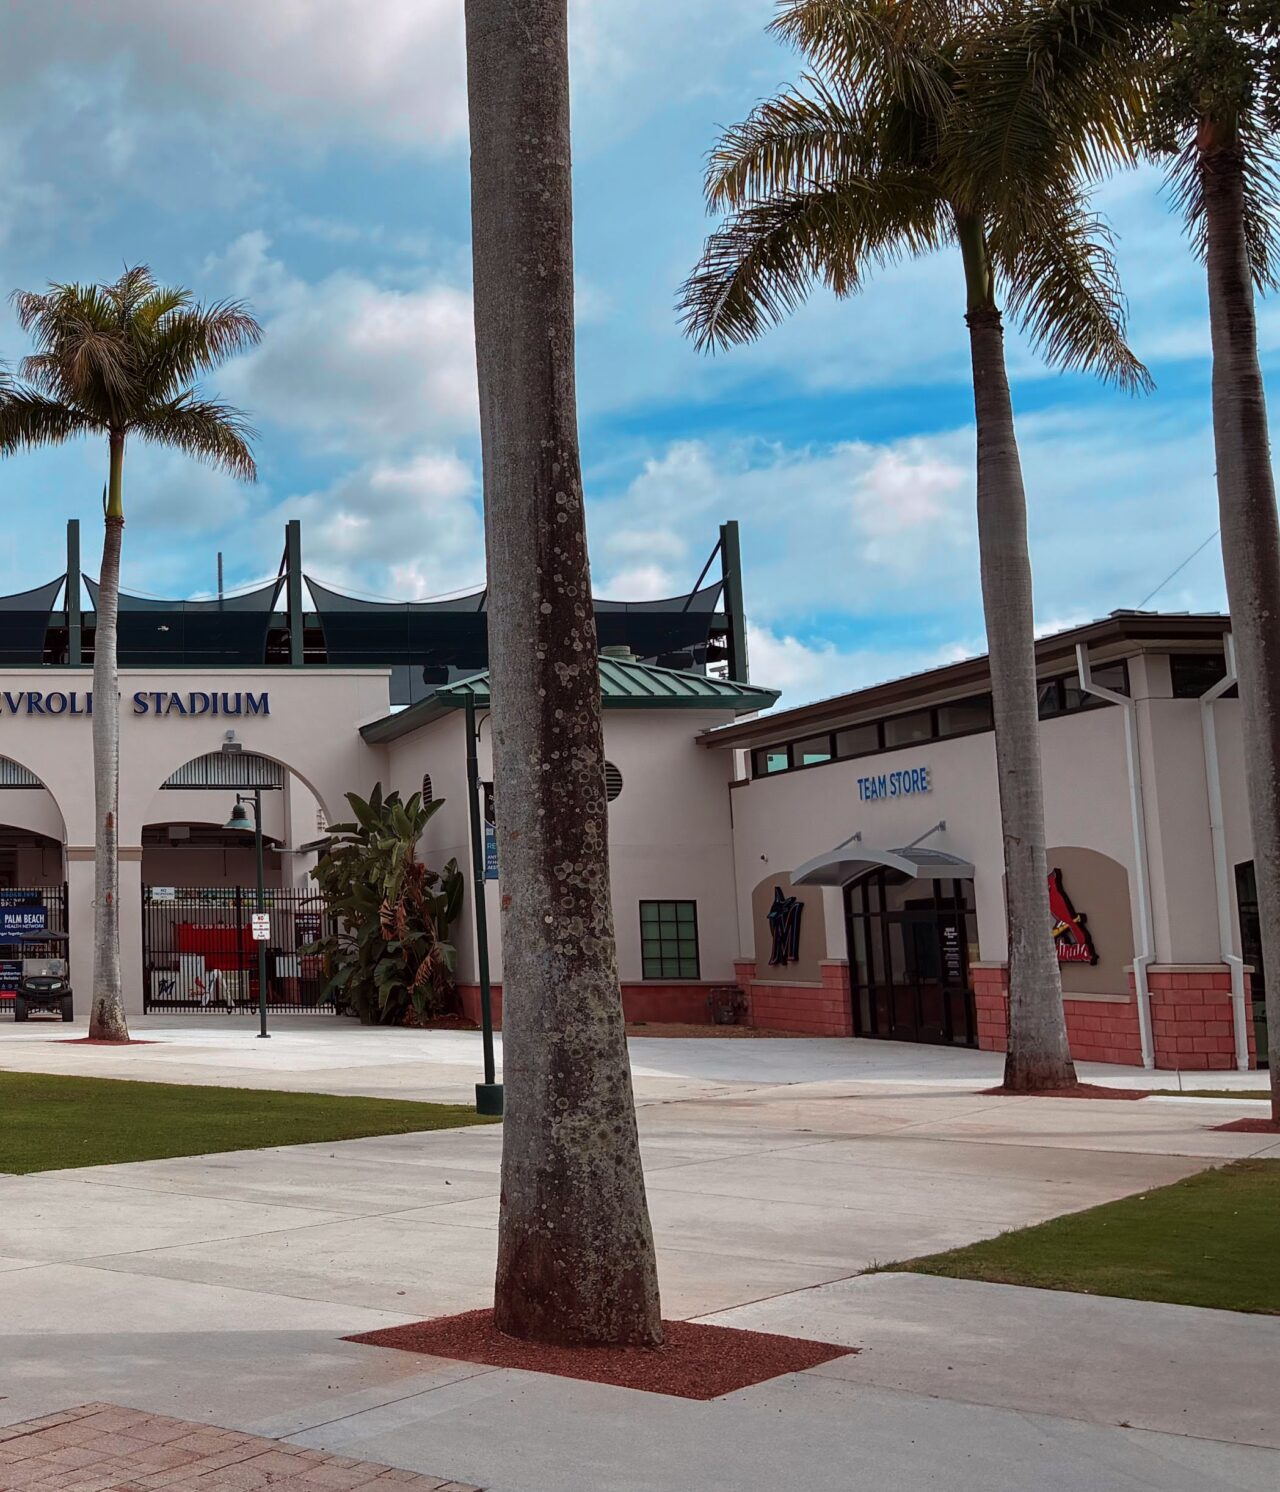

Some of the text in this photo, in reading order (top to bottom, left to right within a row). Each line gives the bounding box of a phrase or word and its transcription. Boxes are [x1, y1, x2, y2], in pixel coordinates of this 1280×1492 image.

[133, 691, 271, 715] STADIUM
[857, 768, 928, 801] TEAM STORE
[4, 914, 45, 924] PALM BEACH
